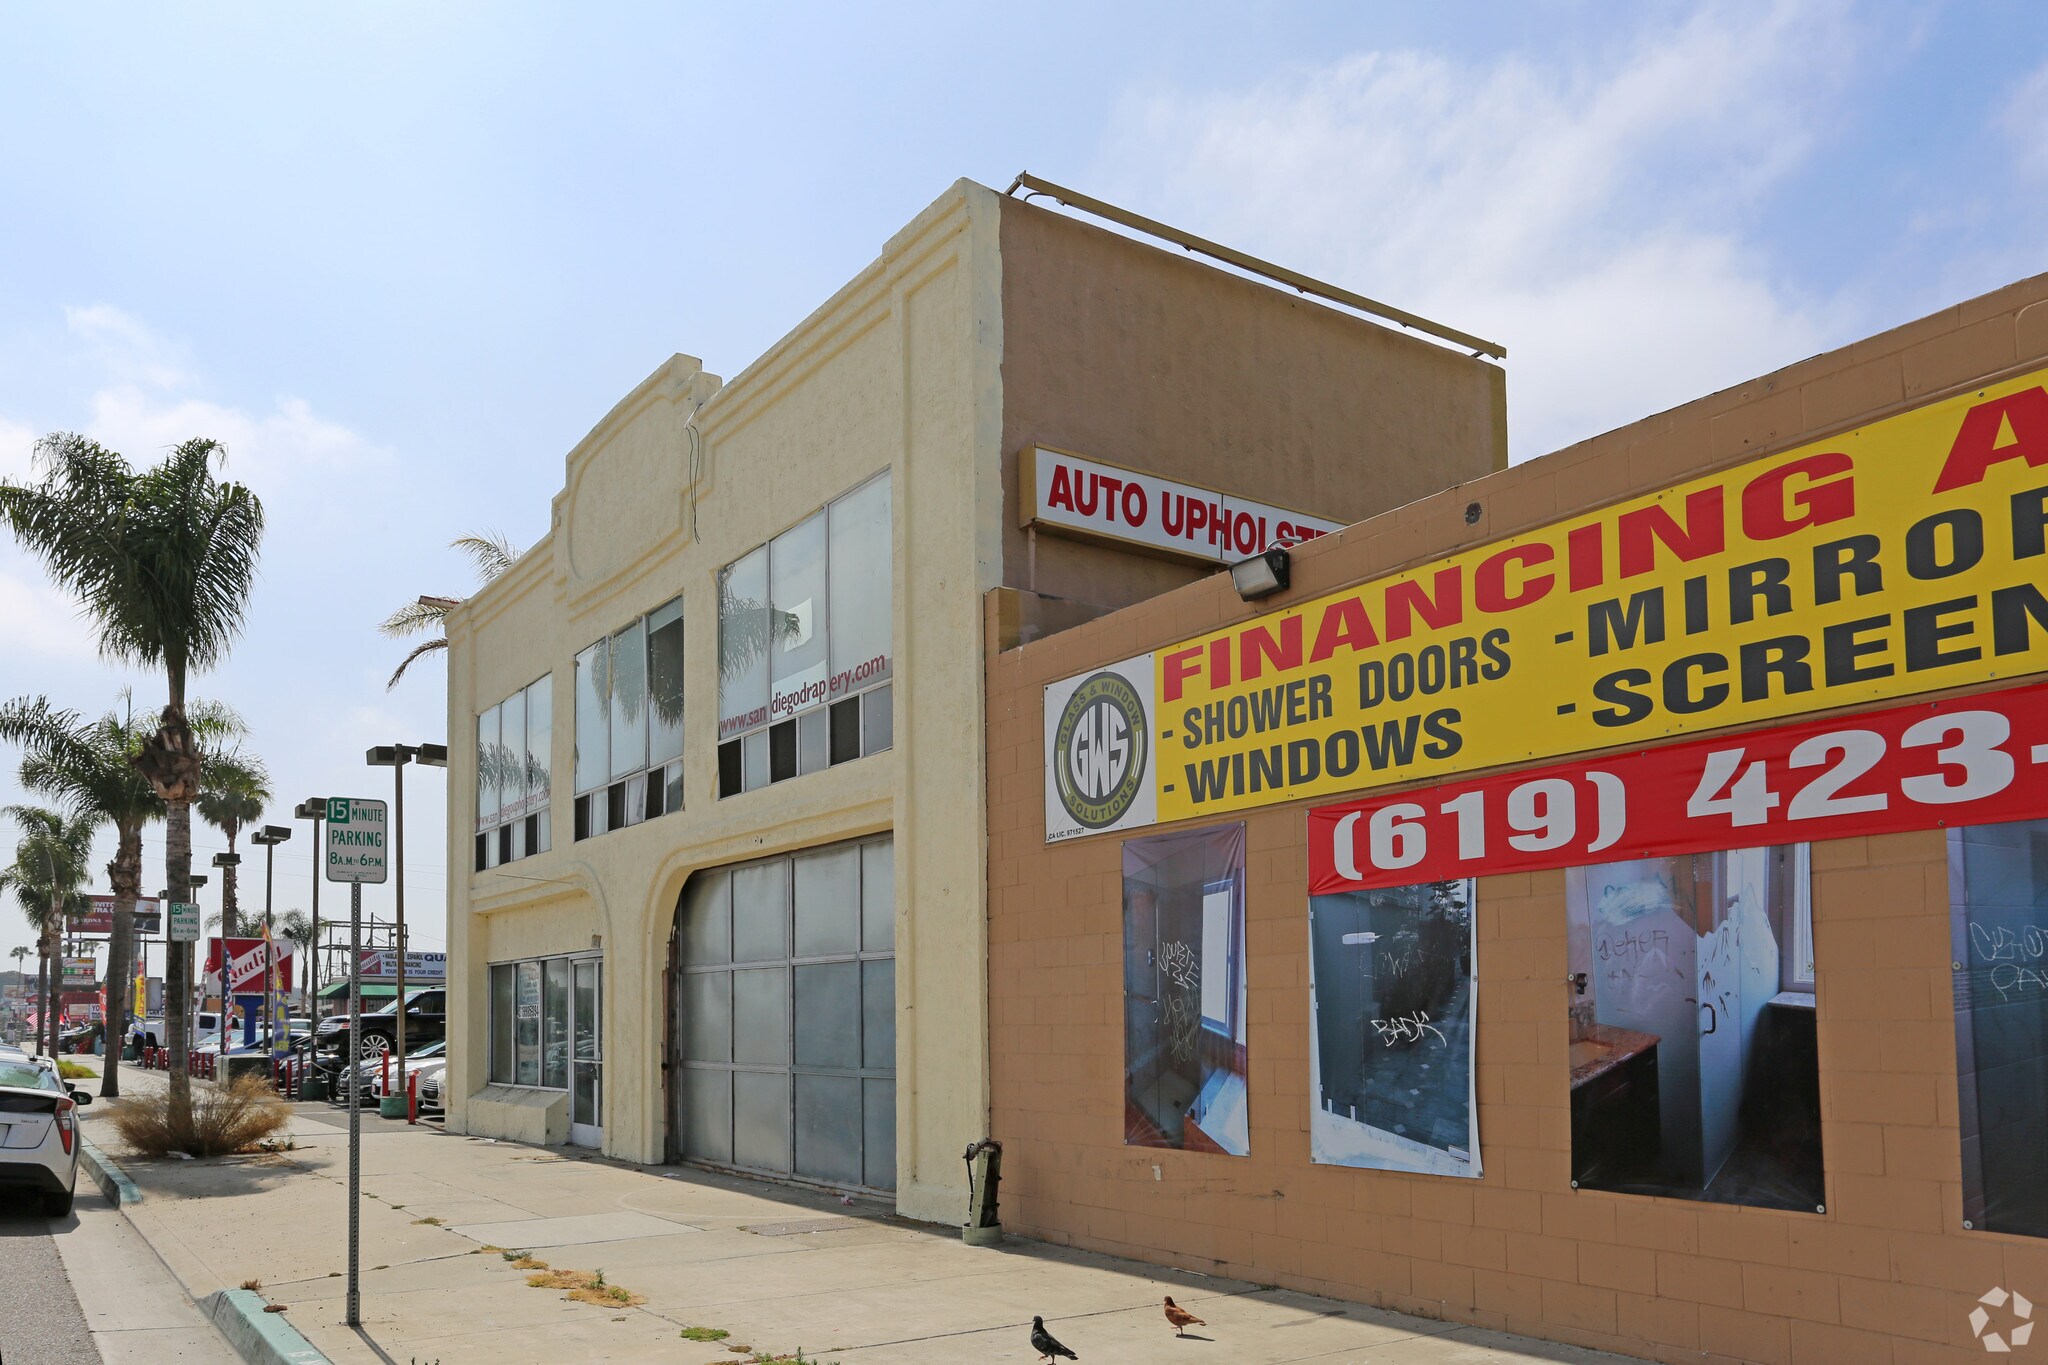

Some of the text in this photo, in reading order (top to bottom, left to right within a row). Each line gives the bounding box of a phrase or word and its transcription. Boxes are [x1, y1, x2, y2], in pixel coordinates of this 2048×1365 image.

[1048, 464, 1148, 528] AUTO
[1163, 453, 1855, 703] FINANCING
[719, 654, 886, 734] www.sandiegodrapery.com
[1358, 628, 1512, 710] DOORS
[1061, 681, 1141, 745] GLASS & WINDOW
[1070, 702, 1129, 799] GWS
[330, 801, 383, 822] 15 MINUTE
[475, 787, 551, 826] www.sandiegouphostery.com
[1069, 779, 1135, 821] SOLUTIONS
[1333, 771, 1627, 881] (619)
[332, 829, 382, 848] PARKING
[1066, 827, 1085, 837] 971527
[172, 905, 181, 913] 15
[174, 917, 197, 925] PARKING
